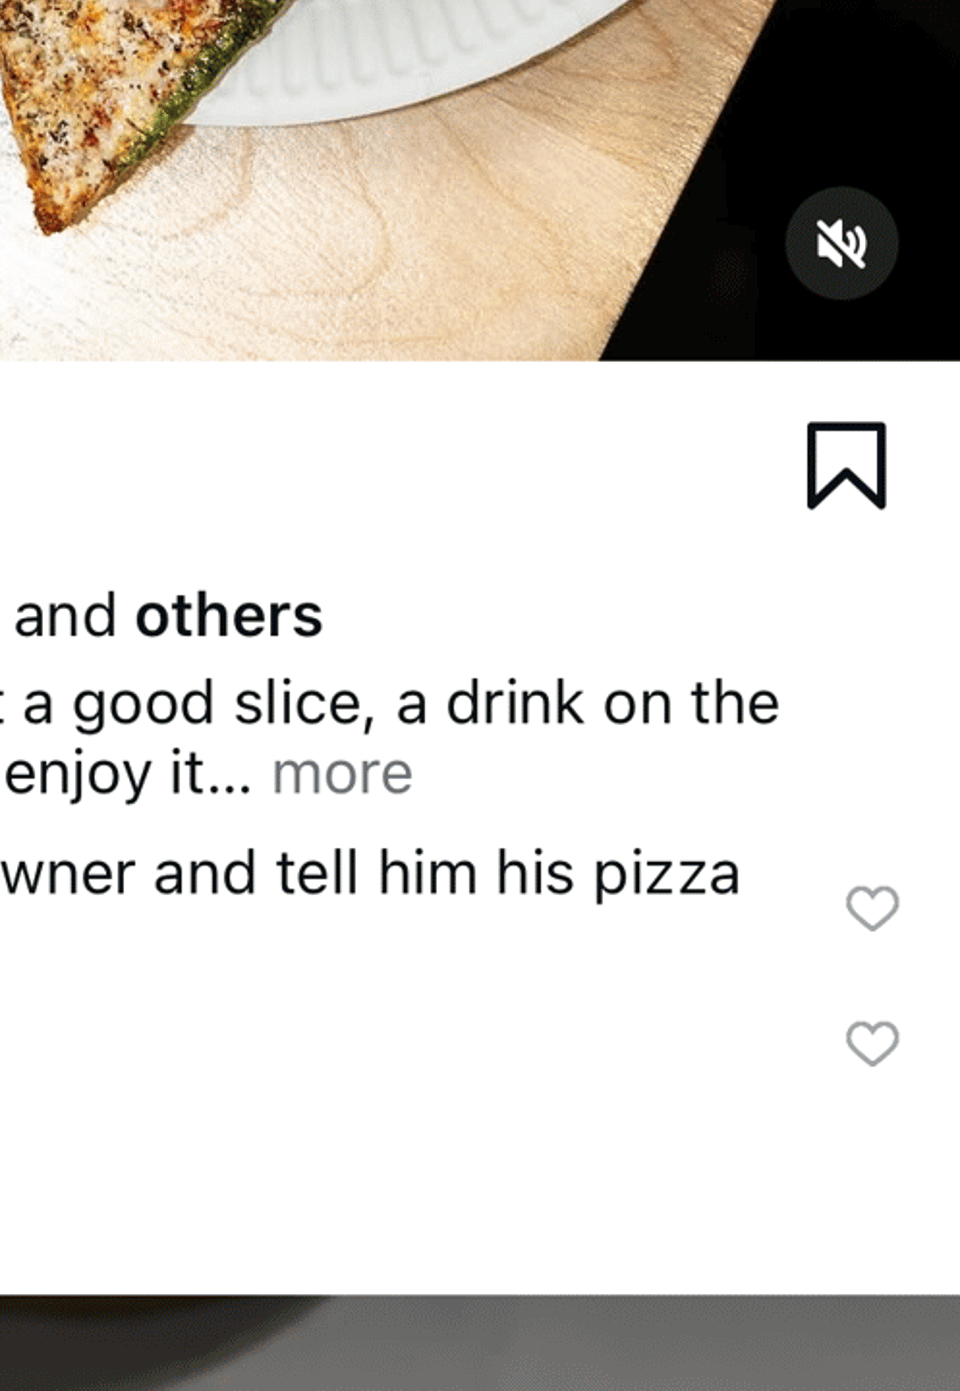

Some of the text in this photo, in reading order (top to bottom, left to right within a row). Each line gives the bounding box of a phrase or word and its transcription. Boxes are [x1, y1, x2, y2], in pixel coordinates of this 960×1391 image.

[15, 590, 116, 638] and
[136, 590, 323, 638] others
[24, 690, 53, 726] a
[74, 677, 213, 736] good
[236, 677, 374, 736] slice,
[398, 690, 426, 726] a
[448, 677, 585, 726] drink
[605, 690, 672, 726] on
[691, 677, 780, 726] the
[4, 747, 153, 806] enjoy
[172, 747, 250, 795] it...
[274, 759, 413, 795] more
[155, 848, 255, 896] and
[276, 848, 357, 896] tell
[381, 848, 477, 895] him
[499, 848, 575, 896] his
[596, 848, 739, 906] pizza
